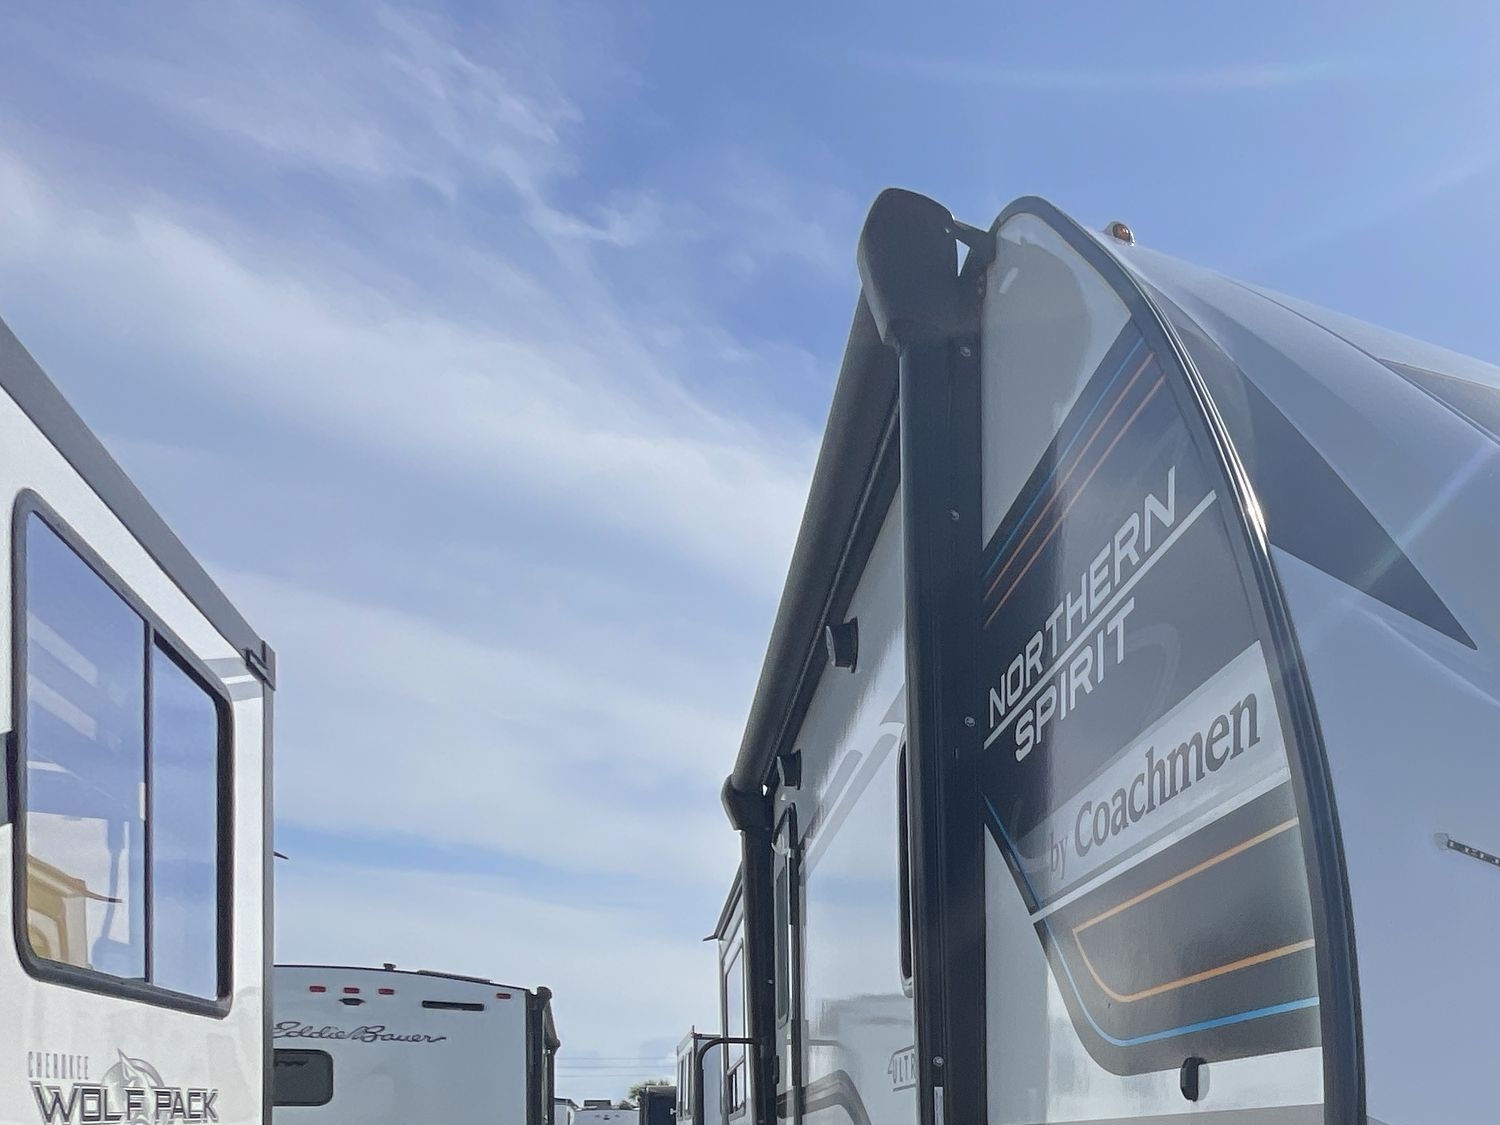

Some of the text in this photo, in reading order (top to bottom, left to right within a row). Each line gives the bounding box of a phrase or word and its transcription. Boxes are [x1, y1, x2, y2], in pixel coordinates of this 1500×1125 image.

[988, 466, 1176, 728] NORTHERN
[1015, 597, 1135, 762] SPIRIT
[1047, 693, 1261, 881] by Coachmen
[149, 1085, 220, 1124] PACK
[273, 1021, 447, 1043] Eddie Bauer
